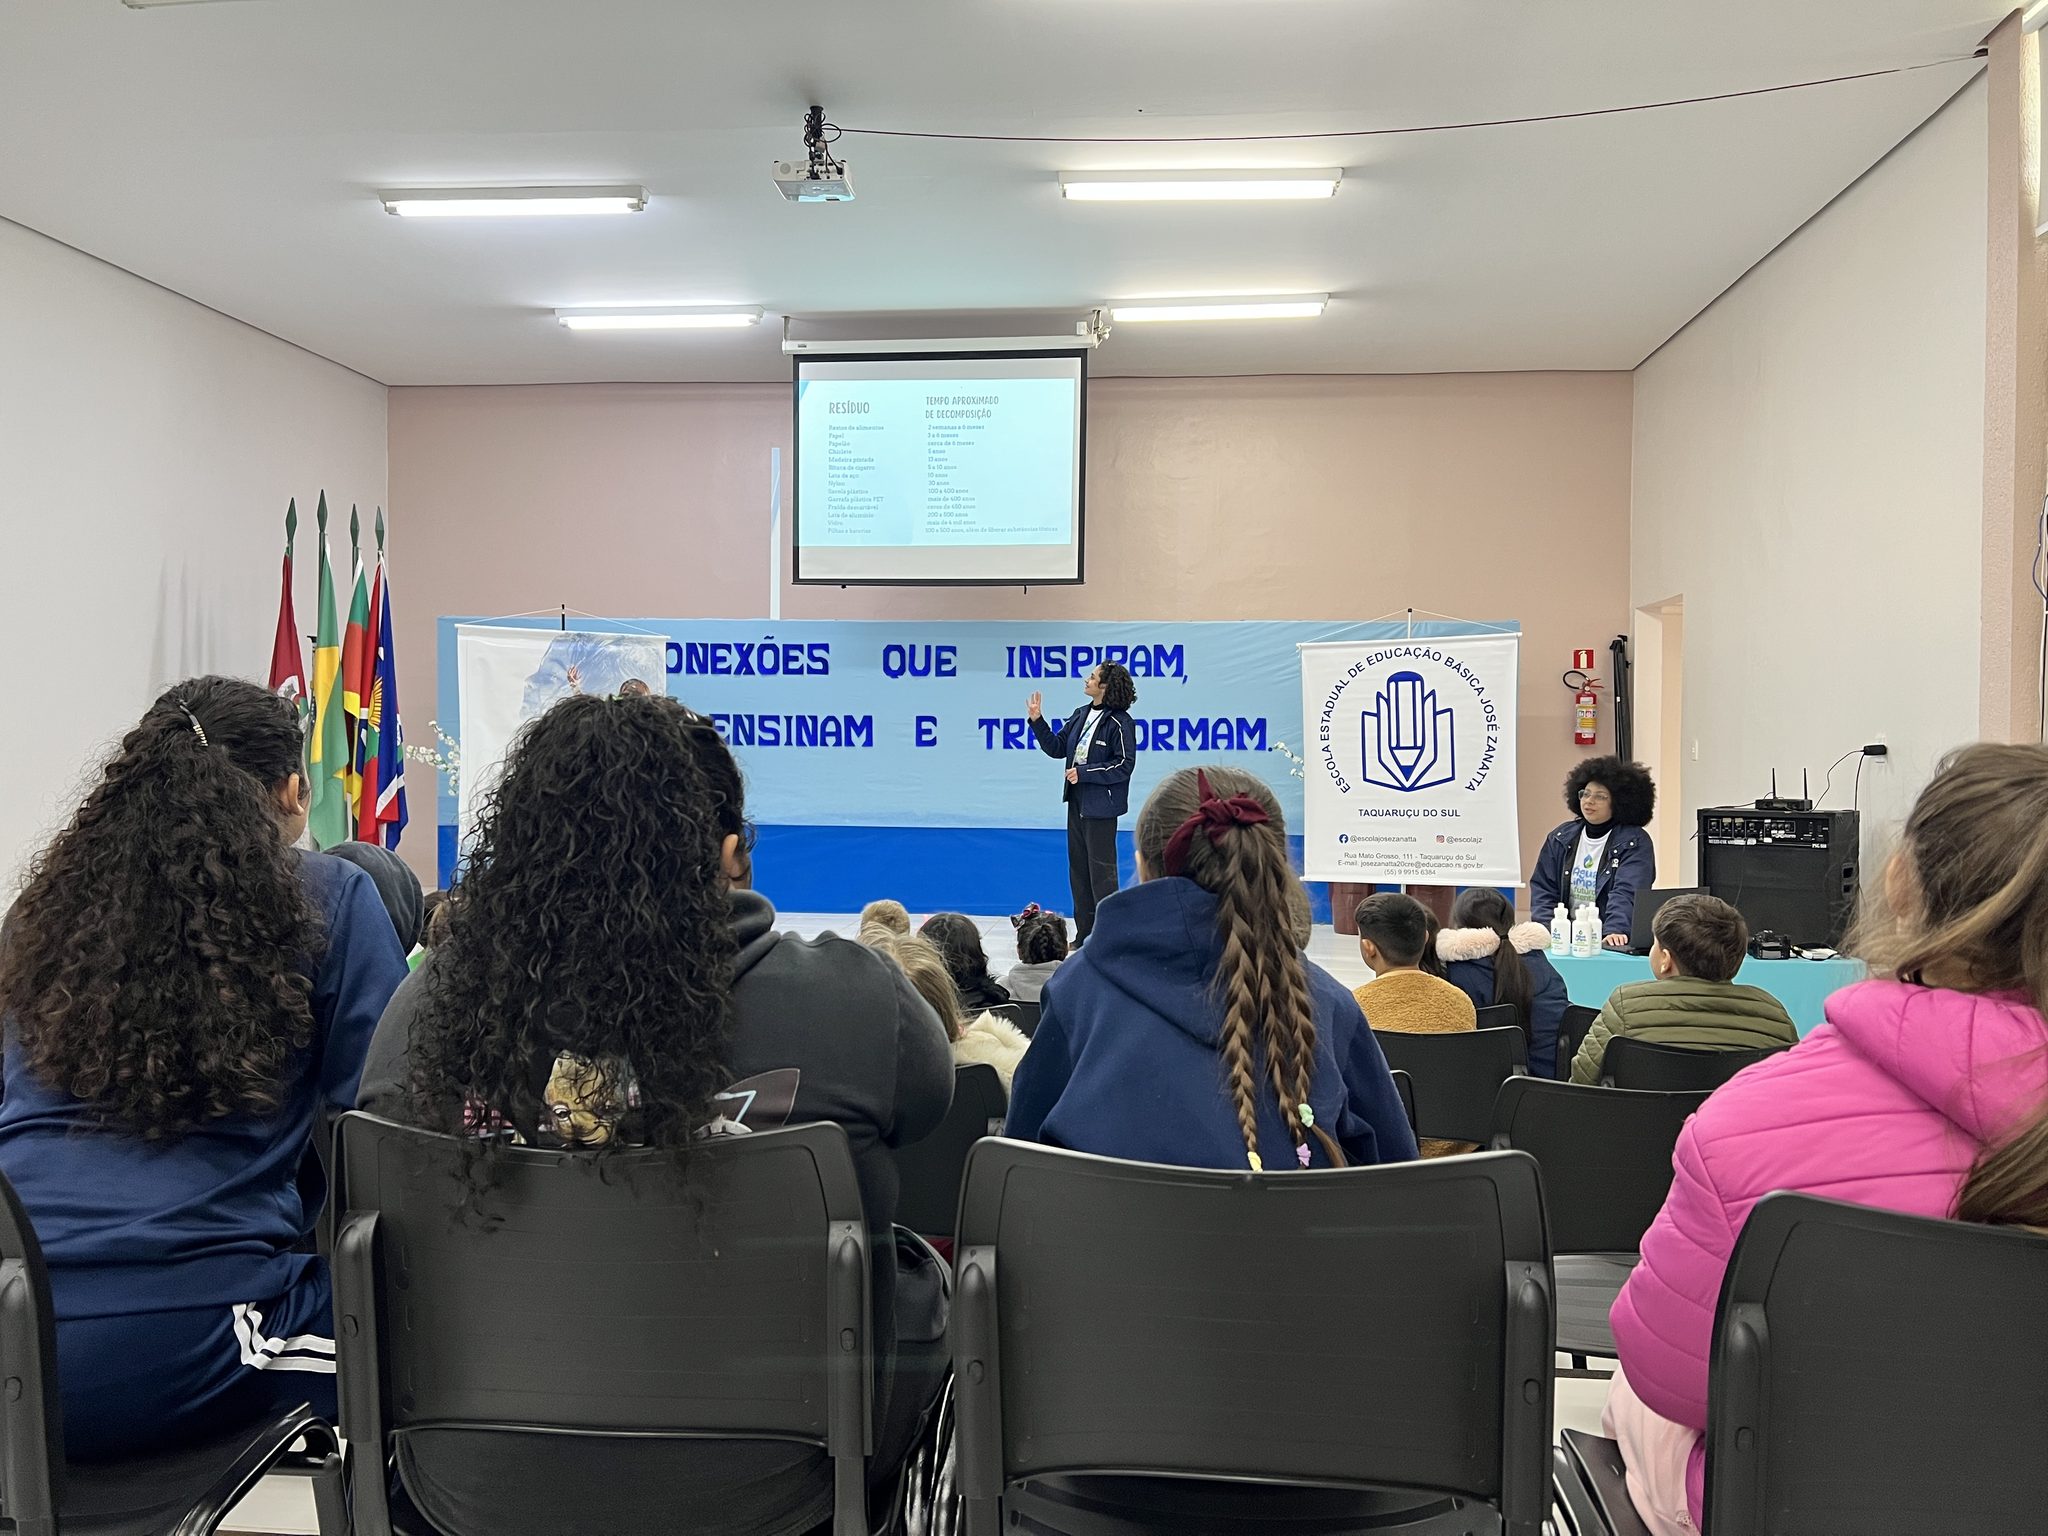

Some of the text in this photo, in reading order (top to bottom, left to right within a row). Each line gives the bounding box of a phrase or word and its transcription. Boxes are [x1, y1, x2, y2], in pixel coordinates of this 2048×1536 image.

[926, 396, 999, 405] TEMPO APROXIMADO
[829, 400, 870, 414] RESÍDUO
[925, 408, 992, 420] DE DECOMPOSIÇÃO
[666, 636, 830, 675] ONEXÕES
[883, 645, 957, 679] QUE
[1320, 647, 1501, 793] ESCOLA ESTADUAL DE EDUCAÇÃO BÁSICA JOSÉ ZANATTA
[709, 714, 1273, 752] ENSINAM E TRORMAM.
[1358, 809, 1461, 818] TAQUARUÇU DO SUL
[1350, 834, 1417, 843] @escolajosezanatta
[1446, 836, 1483, 844] @escolajz
[1420, 853, 1454, 861] Taquaruçu
[1573, 878, 1597, 890] impa
